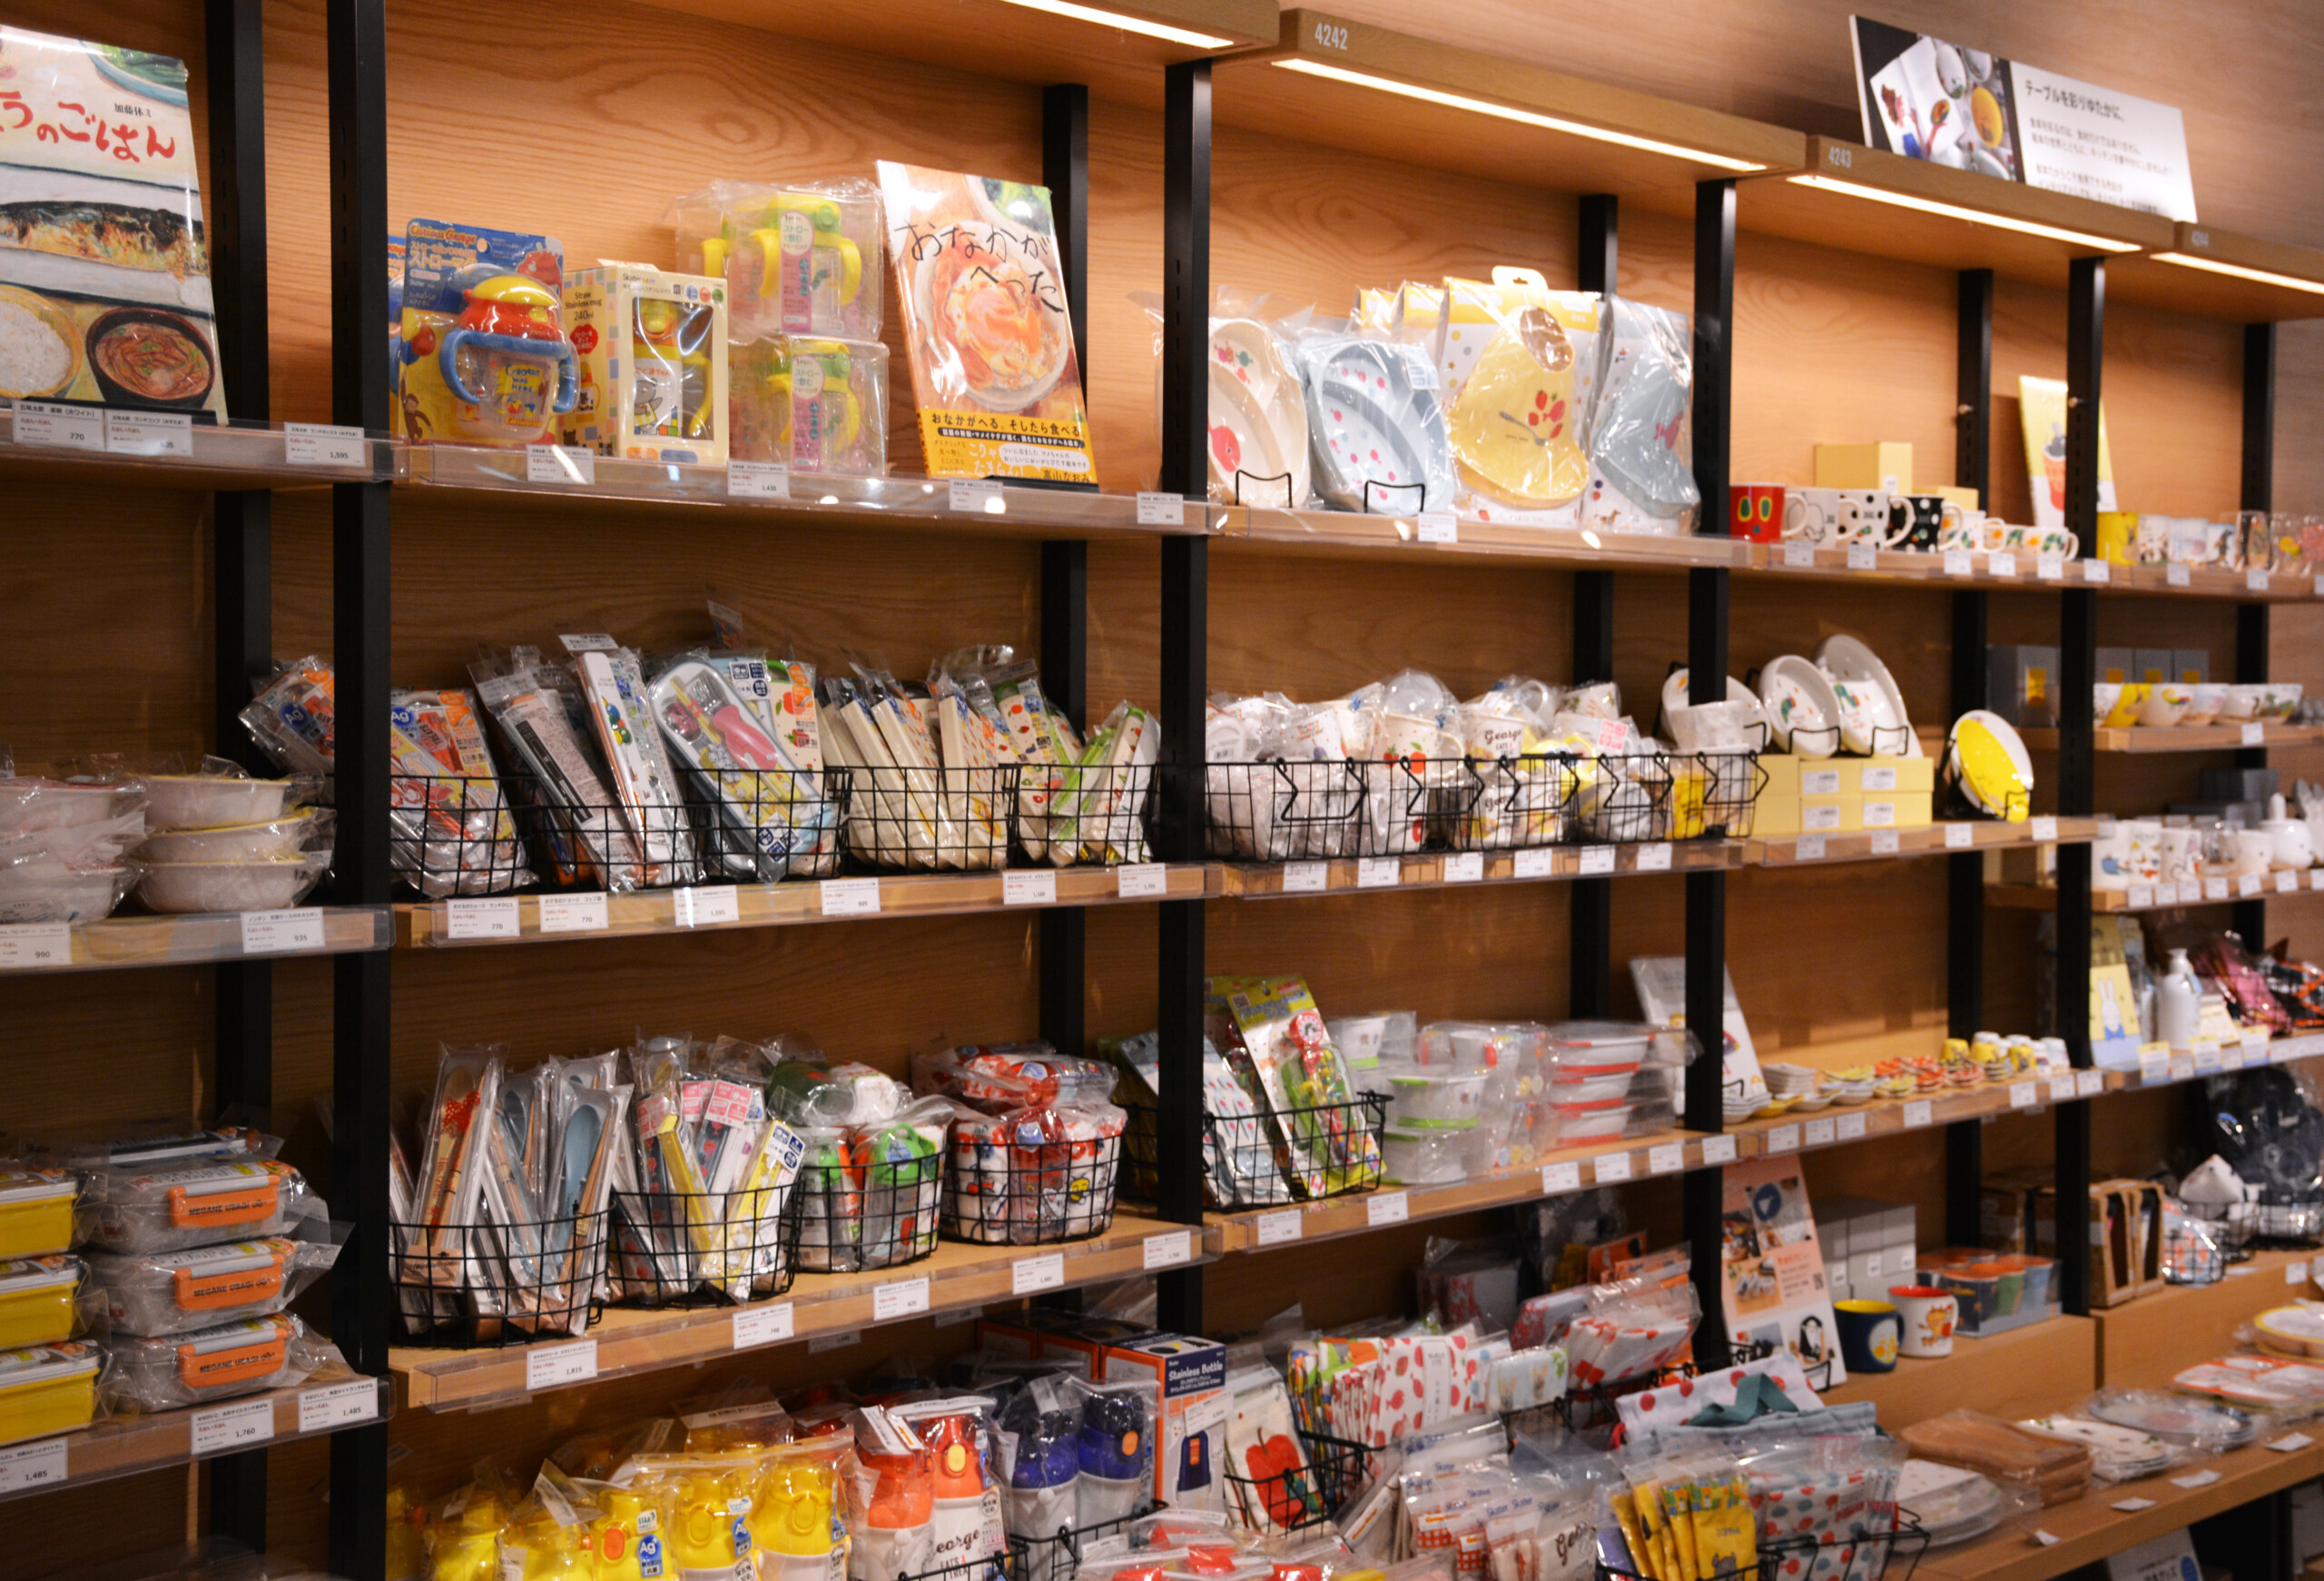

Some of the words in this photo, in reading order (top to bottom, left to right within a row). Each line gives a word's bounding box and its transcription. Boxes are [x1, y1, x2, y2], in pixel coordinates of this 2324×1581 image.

[1315, 22, 1348, 50] 4242
[114, 103, 152, 118] 加藤休ミ
[0, 91, 175, 163] うのごはん
[1828, 146, 1852, 169] 4243
[409, 224, 444, 239] Curious
[445, 227, 477, 246] George
[894, 222, 1051, 262] おなかが
[623, 273, 641, 282] Skater
[575, 291, 591, 300] Straw
[506, 364, 540, 377] GEORGE
[932, 413, 1085, 438] おなかがへる。そしたら食べる。
[70, 432, 84, 440] 770
[970, 442, 997, 458] こりゃ
[1484, 729, 1521, 745] George
[189, 1205, 222, 1216] MEGANE
[225, 1202, 249, 1211] USAGI
[193, 1286, 227, 1297] MEGANE
[230, 1281, 253, 1291] USAGI
[200, 1361, 233, 1373] MEGANE
[234, 1355, 259, 1366] USAGI
[566, 1367, 582, 1375] 1,815
[1168, 1367, 1199, 1381] Stainless
[1201, 1360, 1224, 1375] Bottle
[342, 1407, 361, 1417] 1,485
[236, 1428, 256, 1438] 1,760
[25, 1469, 48, 1481] 1,485
